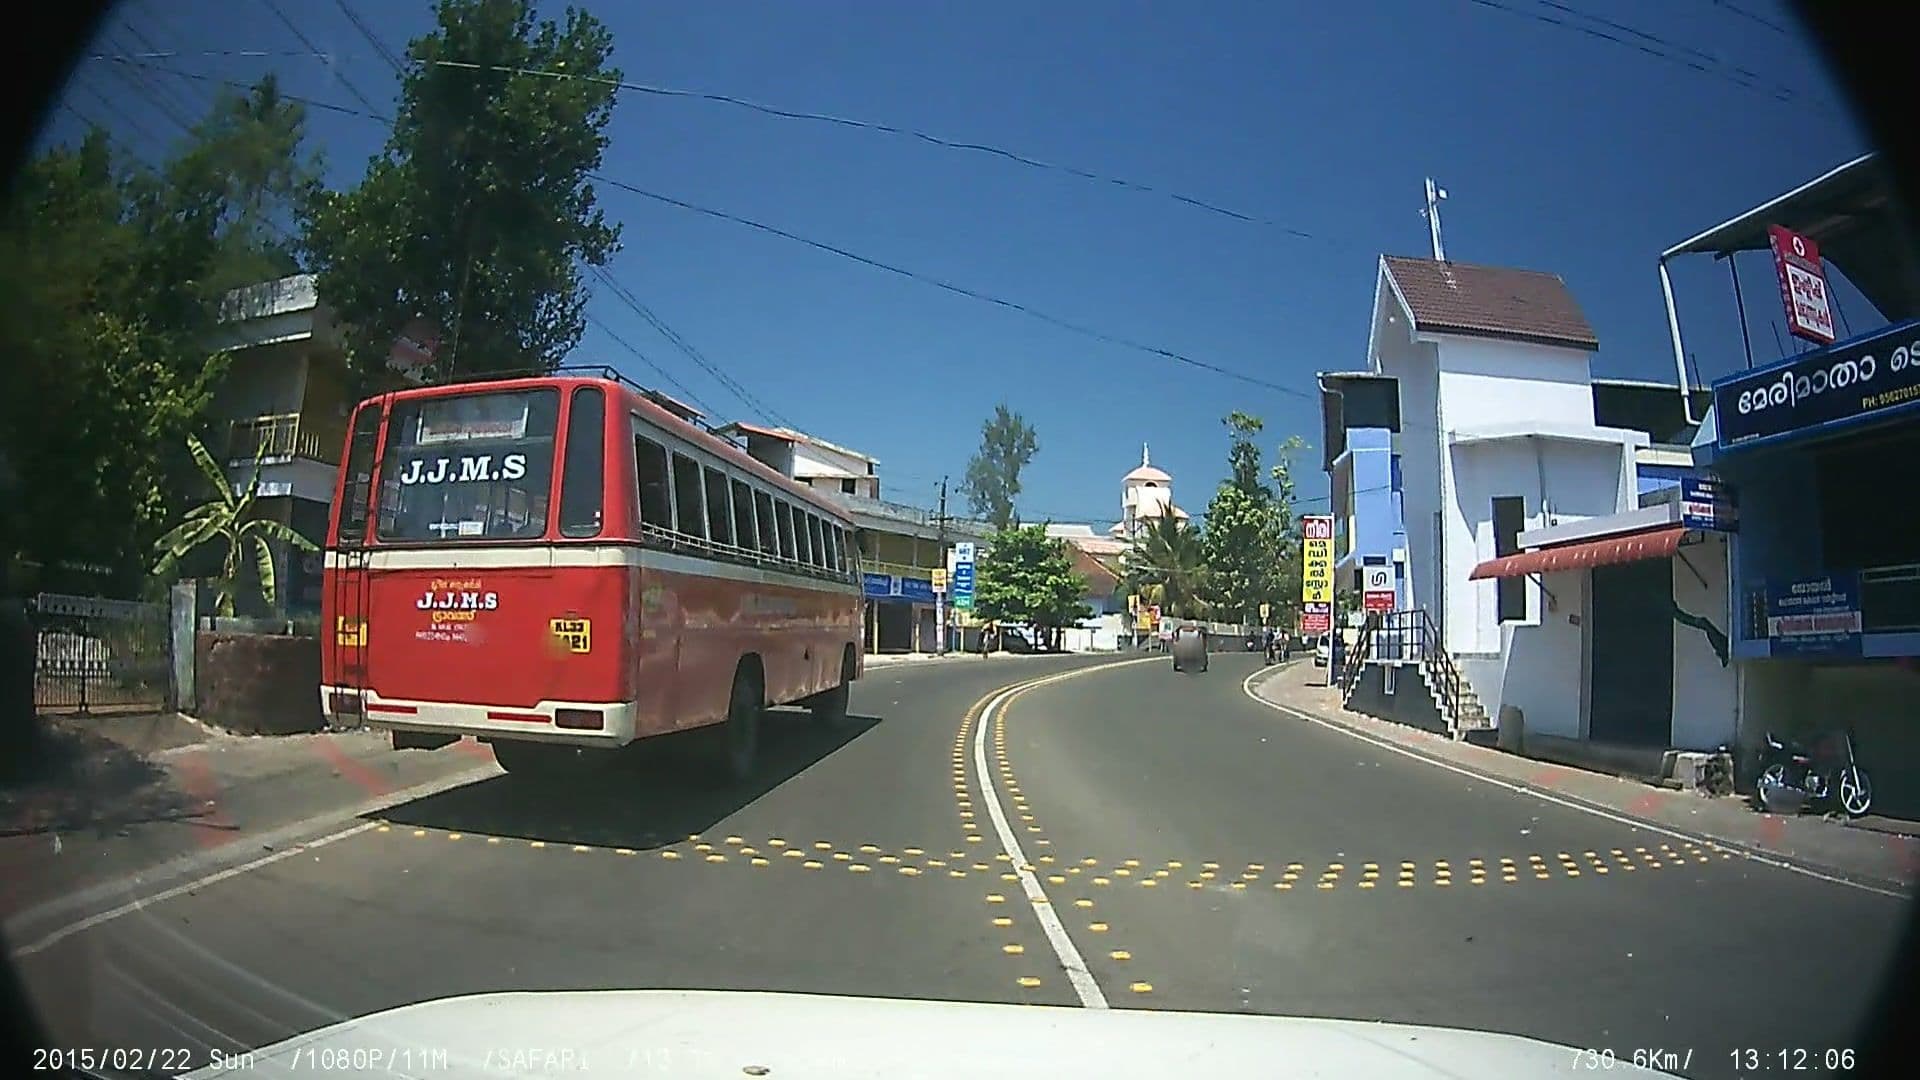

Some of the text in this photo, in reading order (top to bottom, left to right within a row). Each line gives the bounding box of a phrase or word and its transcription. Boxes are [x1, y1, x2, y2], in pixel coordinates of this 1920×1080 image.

[1738, 355, 1876, 415] മേരിമാതാ
[401, 454, 526, 485] J.J.M.S
[416, 592, 498, 609] J.J.M.S
